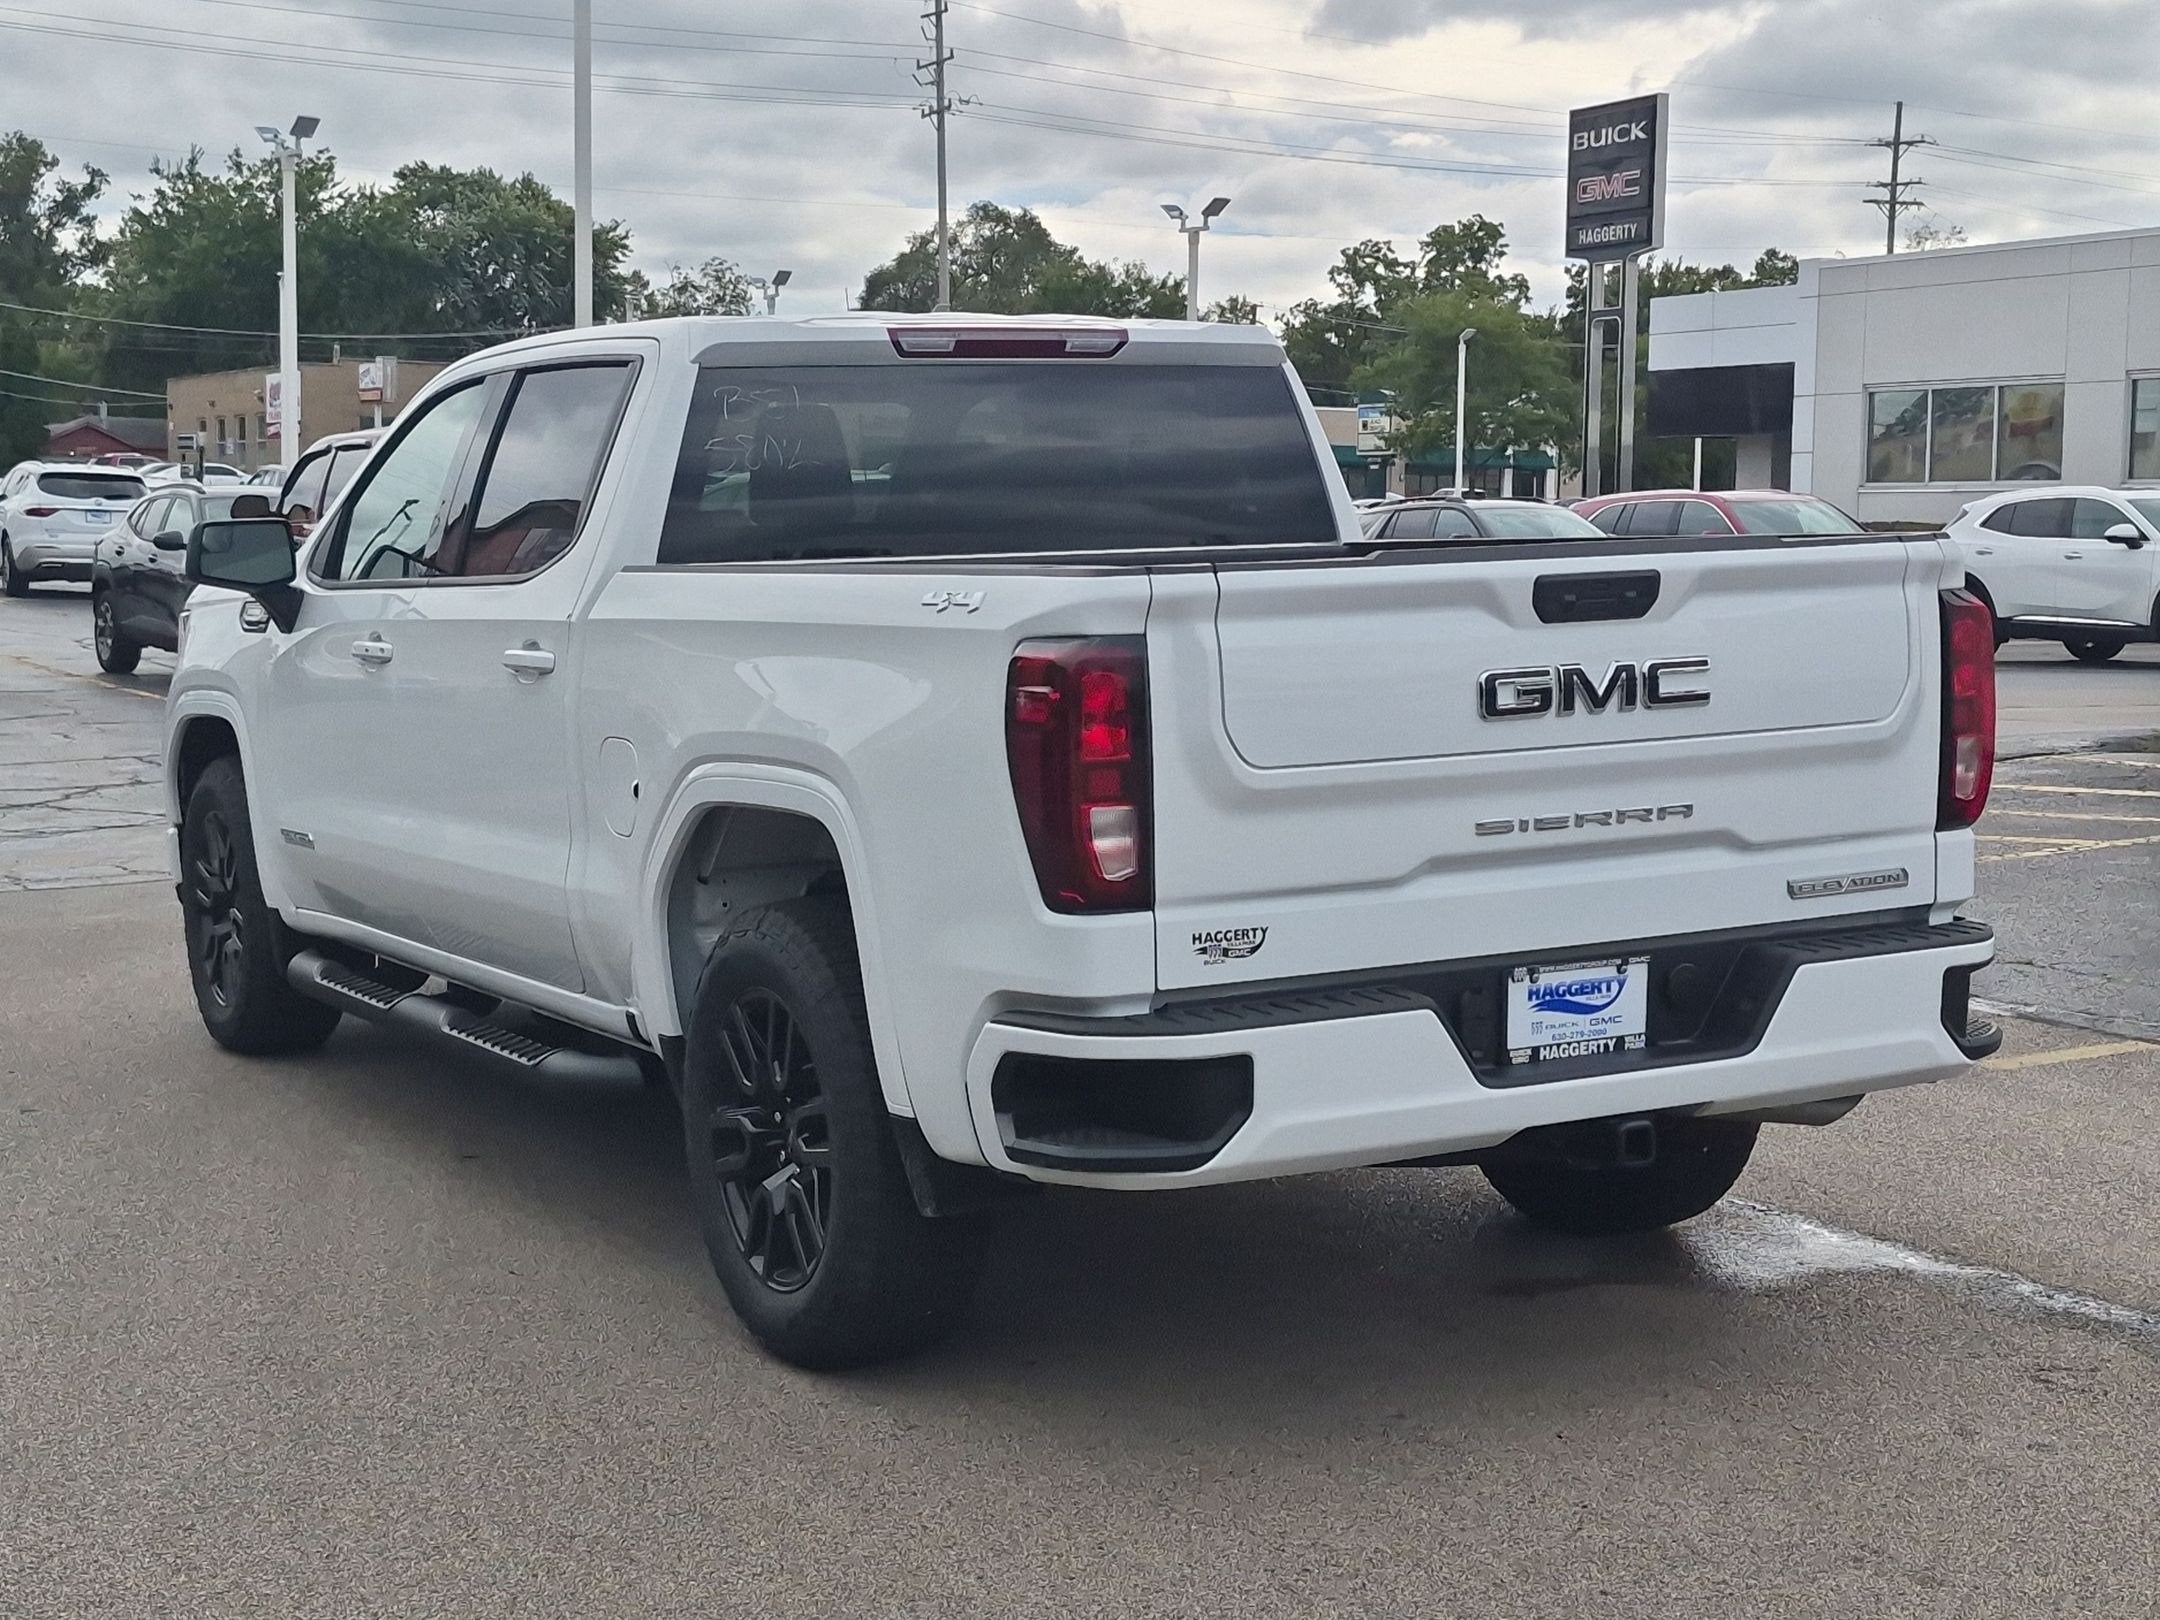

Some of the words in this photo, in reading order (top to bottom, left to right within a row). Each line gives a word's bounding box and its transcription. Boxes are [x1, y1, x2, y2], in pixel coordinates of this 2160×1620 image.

[1573, 120, 1648, 150] BUICK
[1576, 169, 1641, 203] GMC
[1578, 223, 1637, 245] HAGGERTY
[1477, 655, 1711, 722] GMC
[1474, 802, 1694, 836] SIERRA
[1798, 873, 1901, 893] ELEVATION
[1192, 926, 1269, 946] HAGGERTY
[1527, 975, 1629, 1001] HAGGERTY
[1589, 1015, 1623, 1027] GMC
[1551, 1027, 1608, 1042] 630-279-2000
[1539, 1038, 1617, 1061] HAGGERTY
